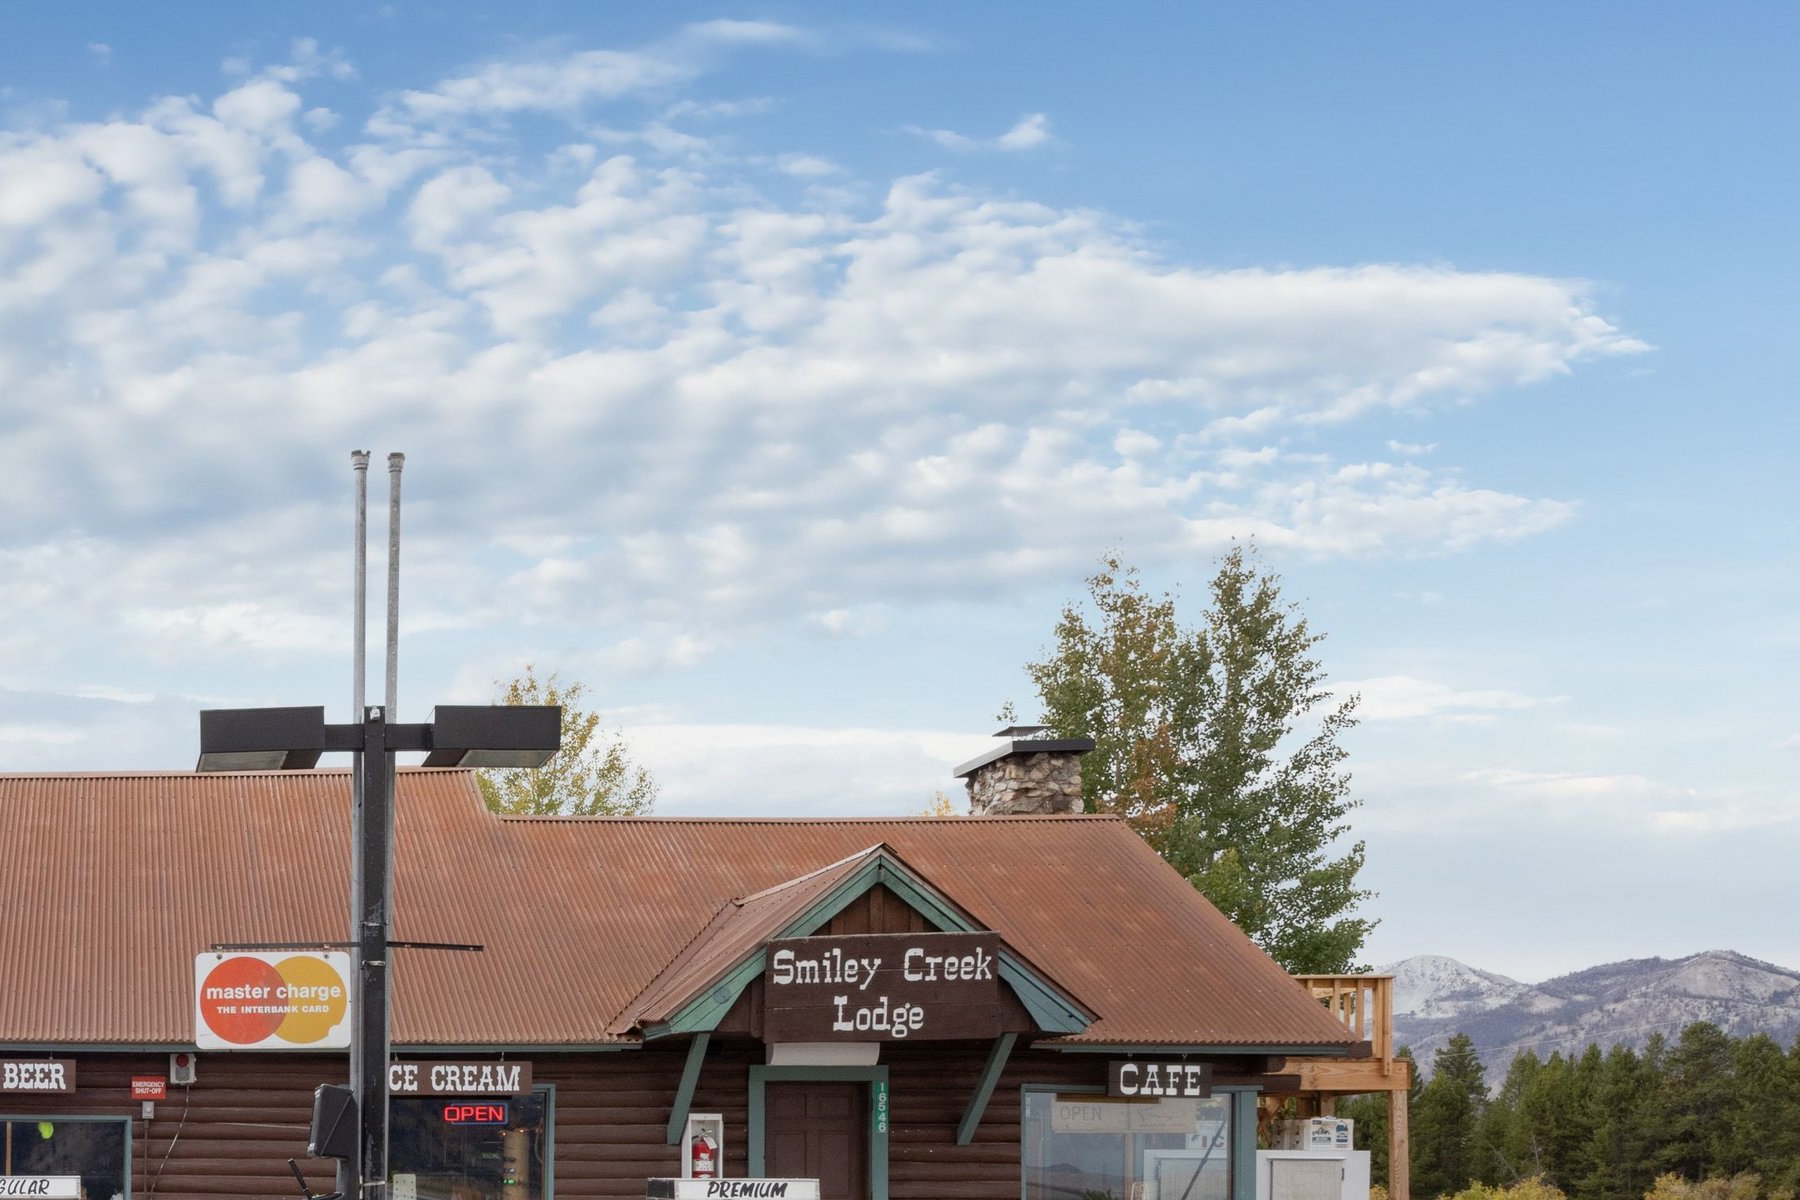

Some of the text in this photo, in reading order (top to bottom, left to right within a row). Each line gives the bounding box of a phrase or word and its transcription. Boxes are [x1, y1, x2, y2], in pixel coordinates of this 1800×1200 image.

[773, 947, 992, 990] Smiley Creek
[206, 983, 341, 1001] master charge
[216, 1005, 329, 1014] THE INTERBANK CARD
[833, 995, 924, 1038] Lodge
[3, 1062, 66, 1090] BEER
[388, 1064, 521, 1092] CE CREAM
[1120, 1063, 1201, 1096] CAFE
[443, 1105, 504, 1122] OPEN
[878, 1082, 887, 1132] 16546
[1060, 1106, 1102, 1121] OPEN
[707, 1181, 788, 1198] PREMIUM
